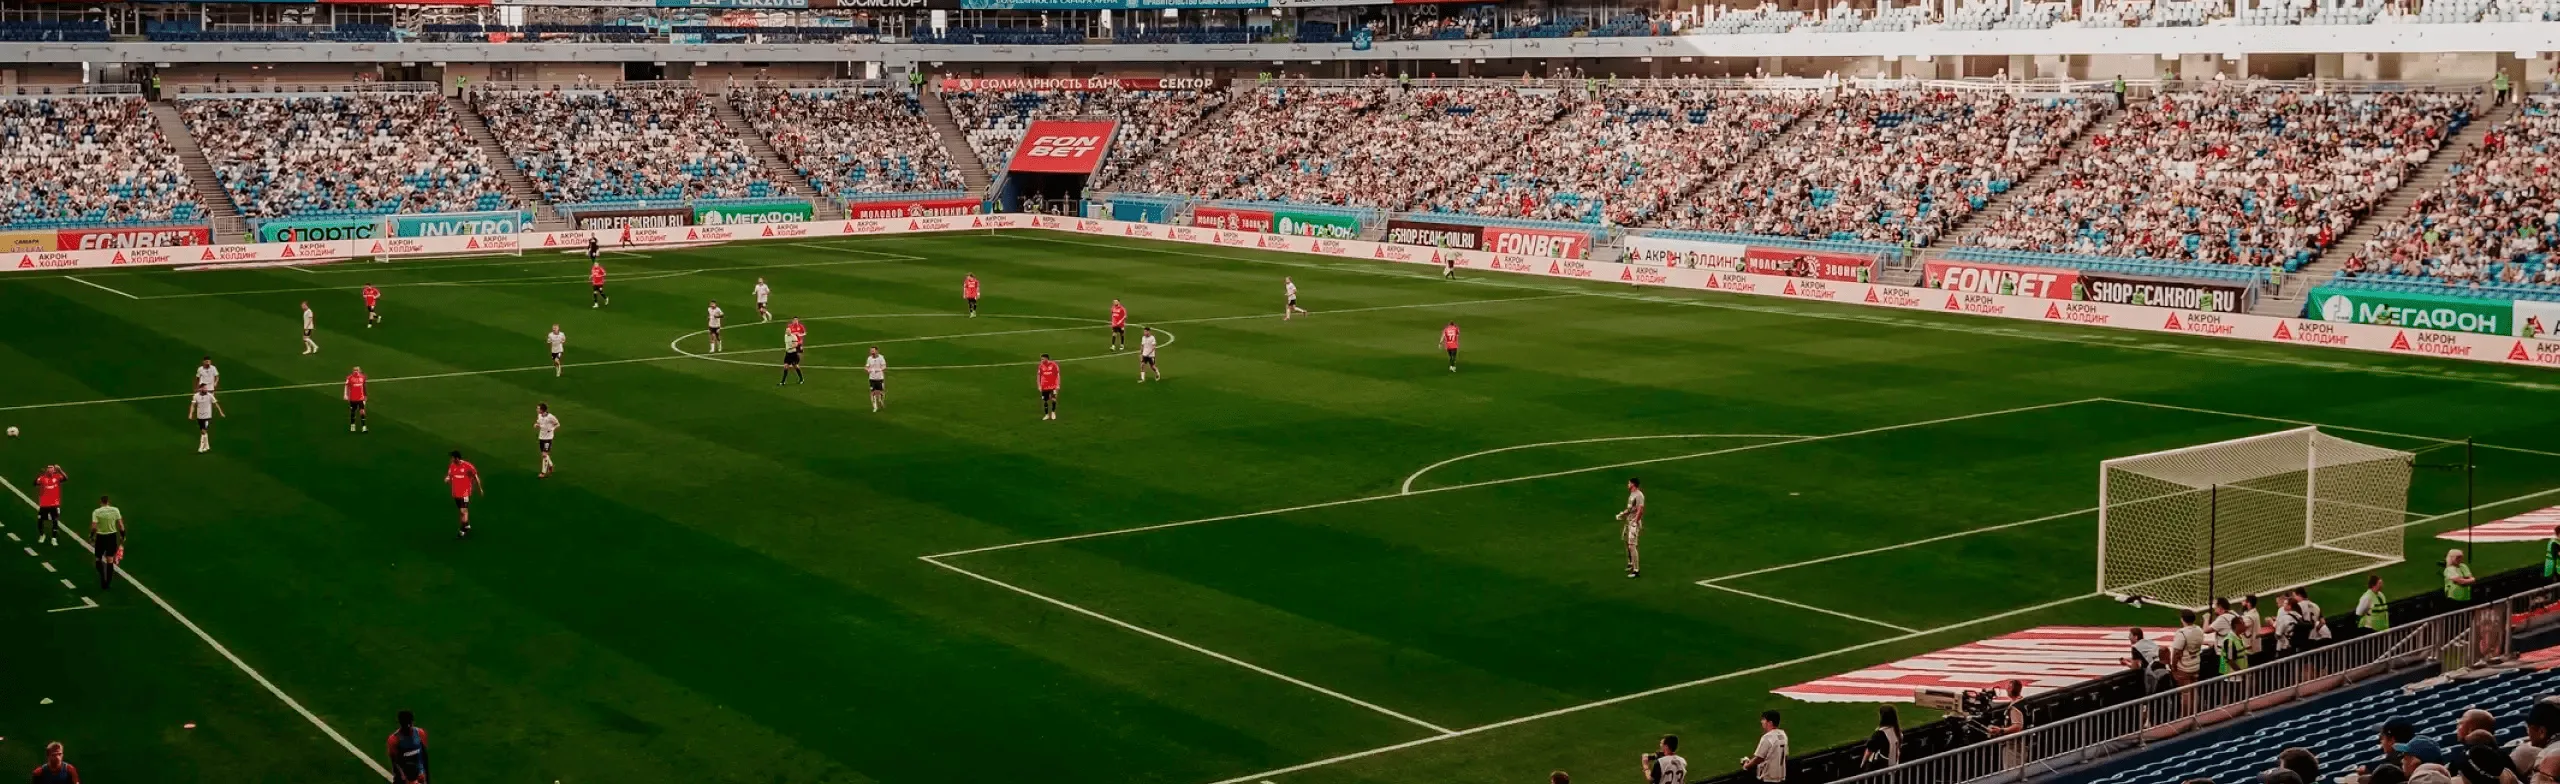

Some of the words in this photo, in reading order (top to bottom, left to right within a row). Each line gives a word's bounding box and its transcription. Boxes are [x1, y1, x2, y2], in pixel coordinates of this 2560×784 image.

[1088, 78, 1121, 89] БАНК
[1160, 78, 1213, 89] СЕКТОР
[1033, 136, 1100, 147] FON
[1027, 145, 1095, 157] BET
[219, 252, 257, 260] ХОЛДИНГ
[300, 249, 335, 257] ХОЛДИНГ
[39, 259, 79, 267] ХОЛДИНГ
[131, 256, 170, 264] ХОЛДИНГ
[1564, 260, 1584, 268] АКРОН
[1636, 266, 1658, 275] АКРОН
[1636, 274, 1667, 284] ХОЛДИНГ
[1723, 273, 1746, 282] АКРОН
[1723, 281, 1755, 292] ХОЛДИНГ
[1801, 280, 1826, 289] АКРОН
[1801, 288, 1835, 300] ХОЛДИНГ
[1883, 287, 1910, 297] АКРОН
[1883, 296, 1920, 307] ХОЛДИНГ
[1964, 294, 1993, 304] АКРОН
[1964, 303, 2005, 314] ХОЛДИНГ
[2066, 303, 2096, 313] АКРОН
[2066, 312, 2109, 324] ХОЛДИНГ
[2188, 313, 2220, 324] АКРОН
[2188, 322, 2234, 335] ХОЛДИНГ
[2298, 322, 2334, 333] АКРОН
[2299, 332, 2349, 345] ХОЛДИНГ
[2417, 332, 2456, 344] АКРОН
[2417, 343, 2472, 356] ХОЛДИНГ
